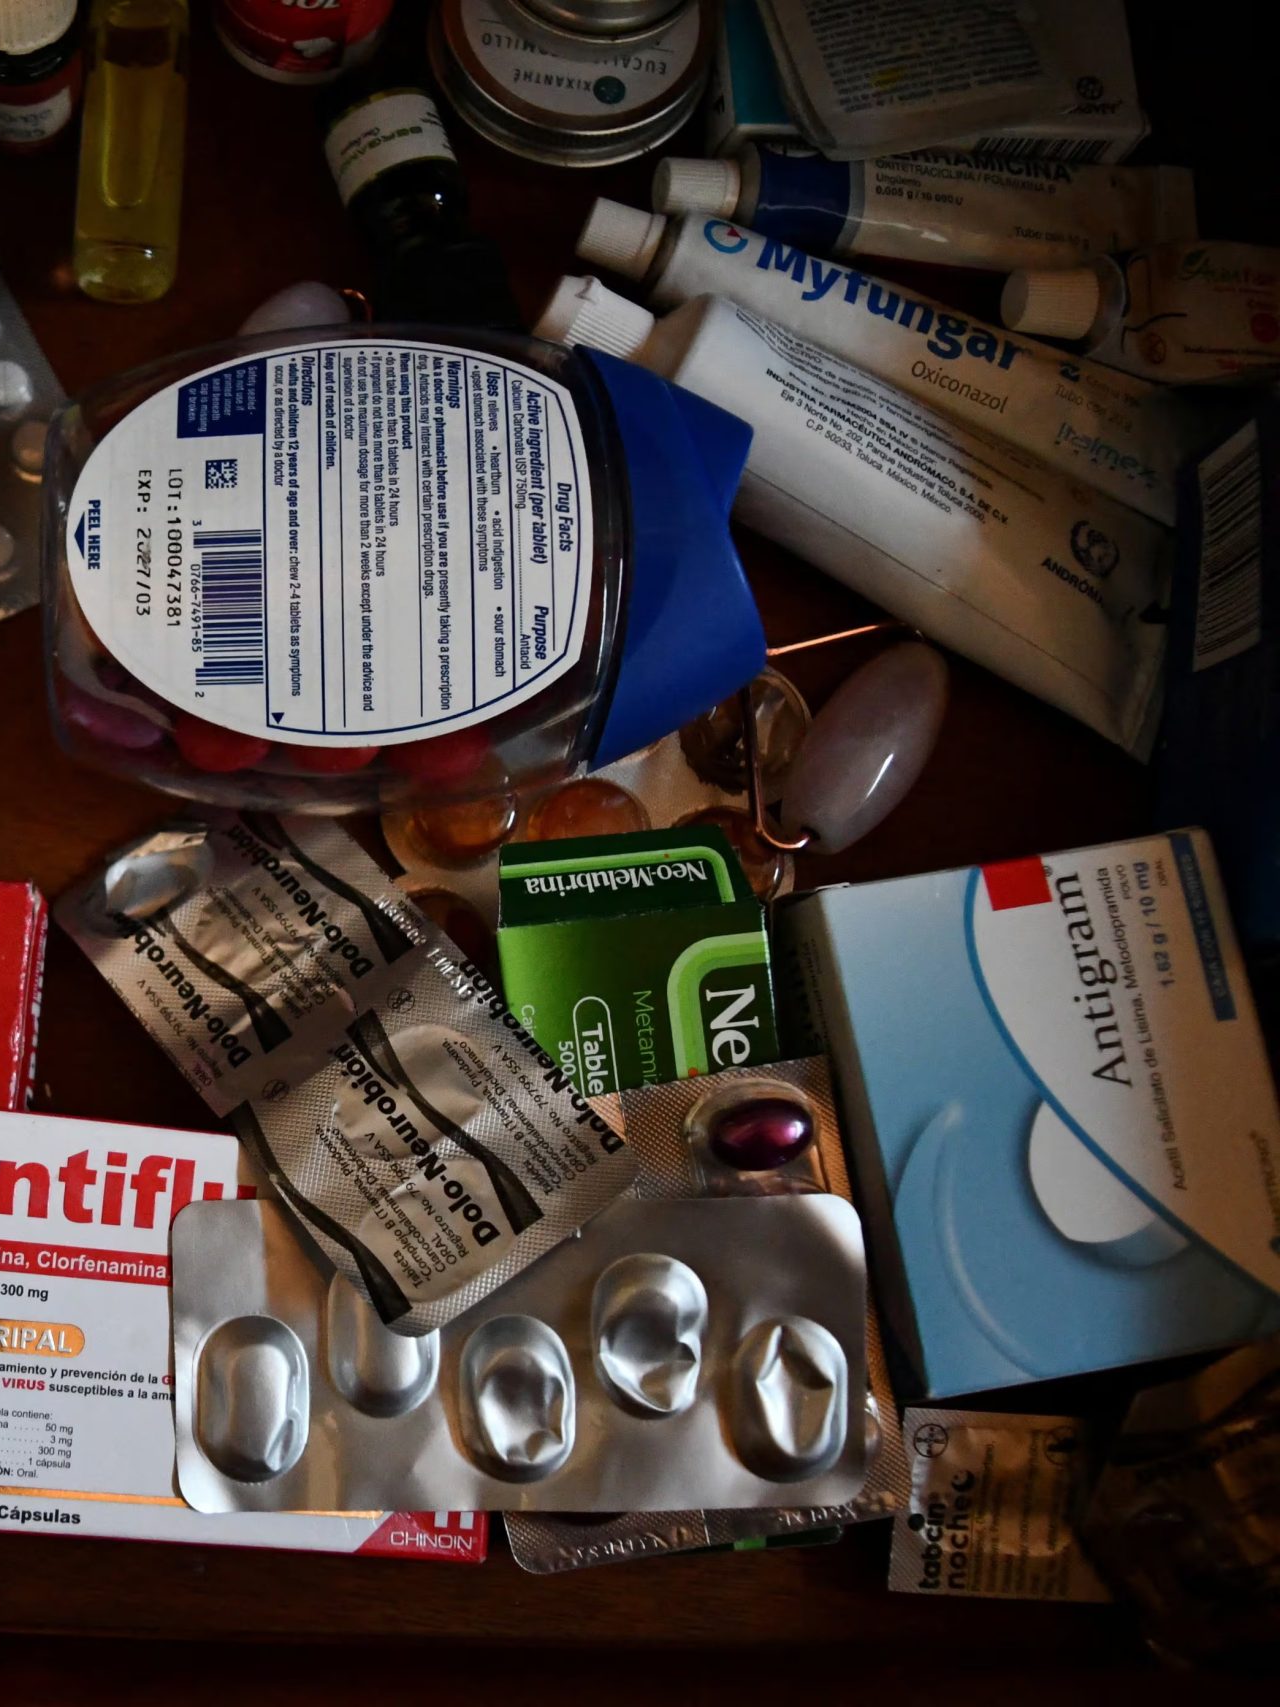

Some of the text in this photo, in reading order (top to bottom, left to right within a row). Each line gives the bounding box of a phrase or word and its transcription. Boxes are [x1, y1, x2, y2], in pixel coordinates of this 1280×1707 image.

[757, 239, 1022, 370] Myfungar
[301, 356, 315, 407] Directions
[324, 352, 336, 370] Keep
[325, 371, 336, 385] out
[446, 360, 462, 409] Warnings
[911, 360, 1009, 414] Oxiconazol
[325, 395, 336, 418] reach
[398, 352, 413, 450] When using this product
[766, 368, 816, 404] INDUSTRIA
[818, 401, 891, 450] FARMACÉUTICA
[326, 429, 337, 470] children.
[804, 403, 827, 422] Norte
[866, 441, 895, 466] Parque
[137, 468, 152, 513] EXP:
[555, 482, 573, 552] Drug Facts
[88, 499, 101, 570] PEEL HERE
[486, 371, 506, 678] Uses relieves heartburn acid indigestion sour stomach
[511, 380, 531, 670] Calcium Carbonate USP 750mg Antacid
[526, 390, 549, 660] Active ingredient (per tablet) Purpose
[191, 563, 202, 652] 0766-7491-85
[524, 860, 708, 897] Neo-Melubrina
[1098, 867, 1137, 988] Metoclopramida
[37, 1250, 167, 1279] Clorfenamina
[390, 1531, 473, 1550] CHINOIN
